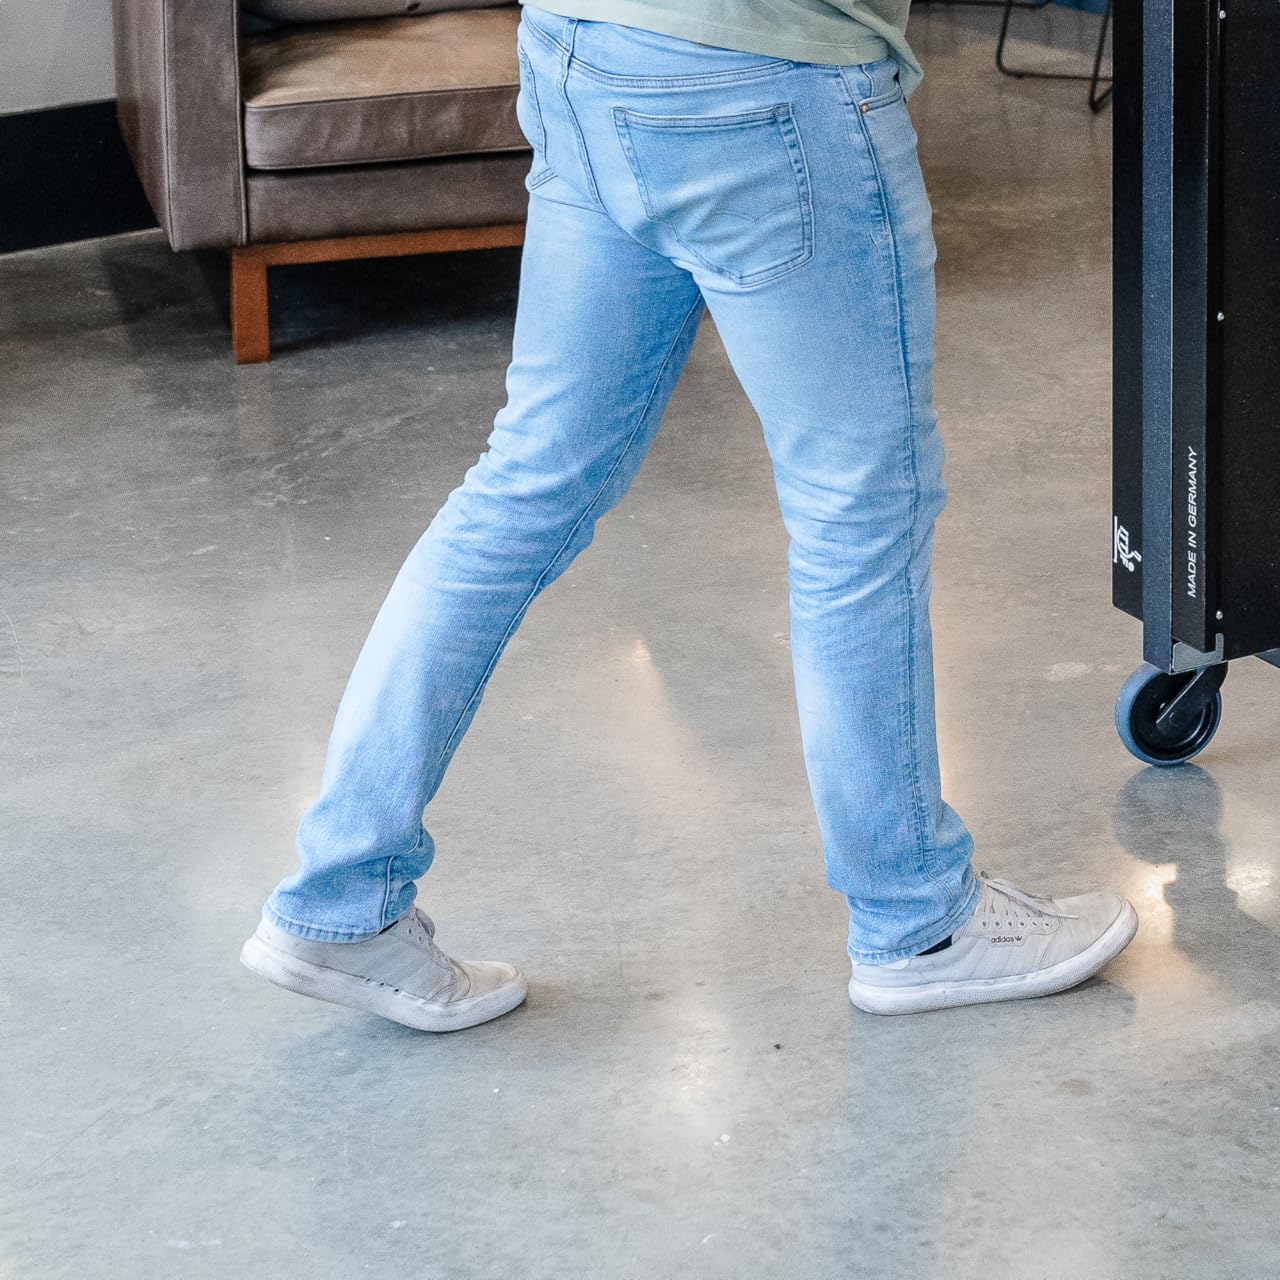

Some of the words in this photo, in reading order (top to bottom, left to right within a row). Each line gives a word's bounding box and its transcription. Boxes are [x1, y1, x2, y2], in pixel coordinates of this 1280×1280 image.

[1188, 446, 1198, 527] GERMANY
[1188, 530, 1197, 548] IN
[1187, 550, 1197, 598] MADE
[990, 935, 1015, 944] adidas
